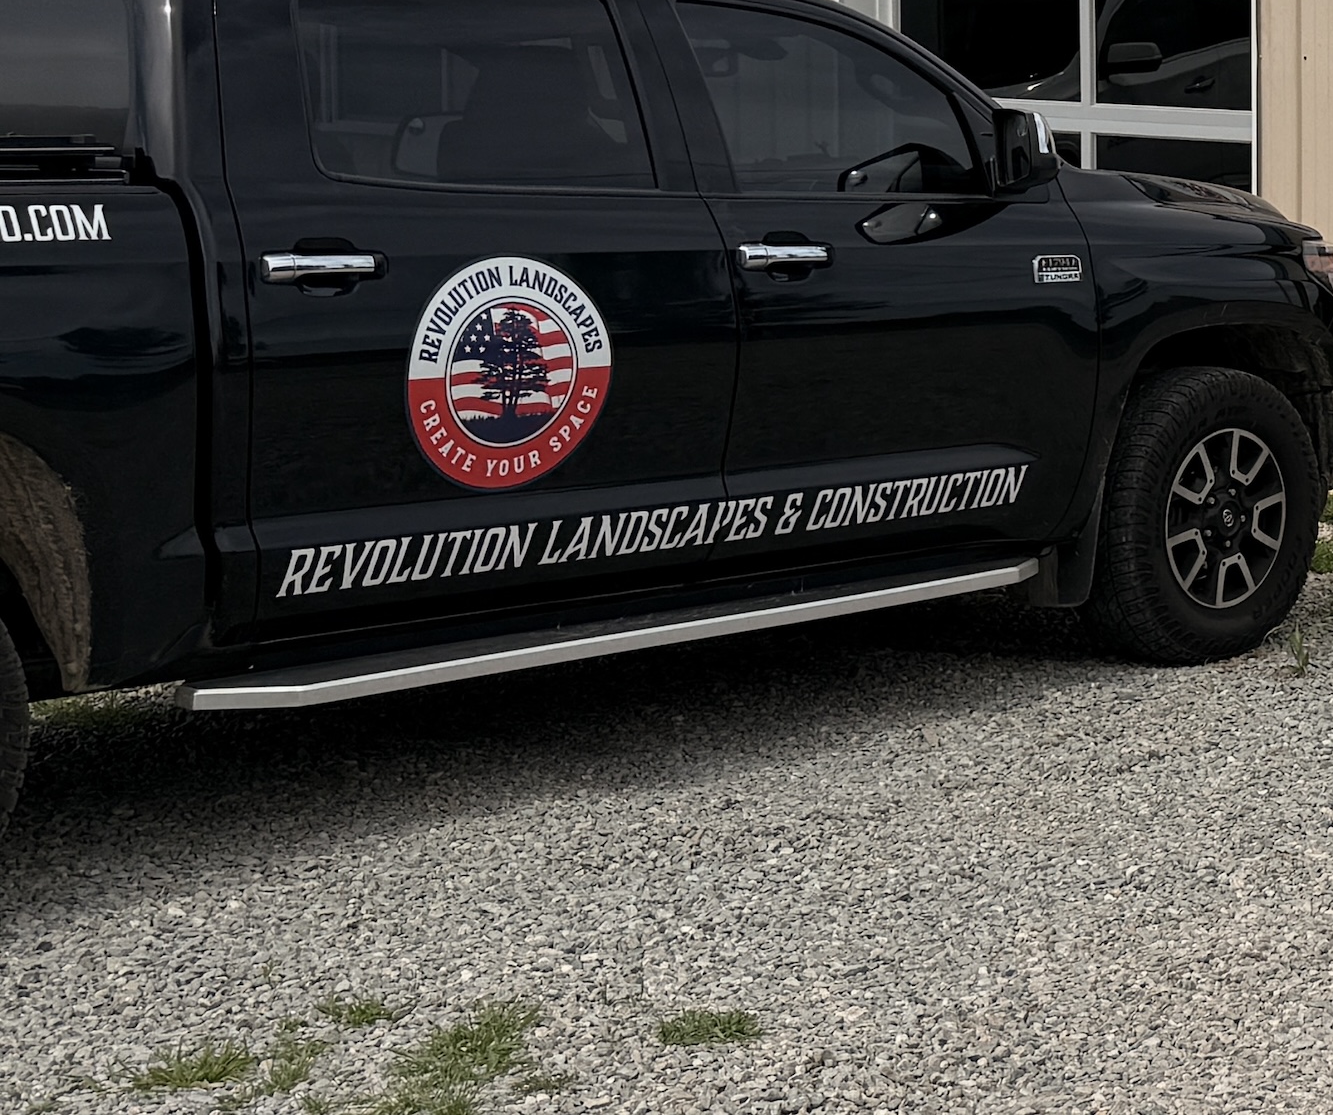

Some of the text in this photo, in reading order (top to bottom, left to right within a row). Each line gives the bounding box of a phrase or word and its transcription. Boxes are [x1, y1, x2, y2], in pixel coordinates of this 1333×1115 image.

[419, 265, 603, 364] REVOLUTION LANDSCAPES
[420, 385, 598, 477] CREATE YOUR SPACE
[275, 465, 1028, 598] REVOLUTION LANDSCAPES & CONSTRUCTION
